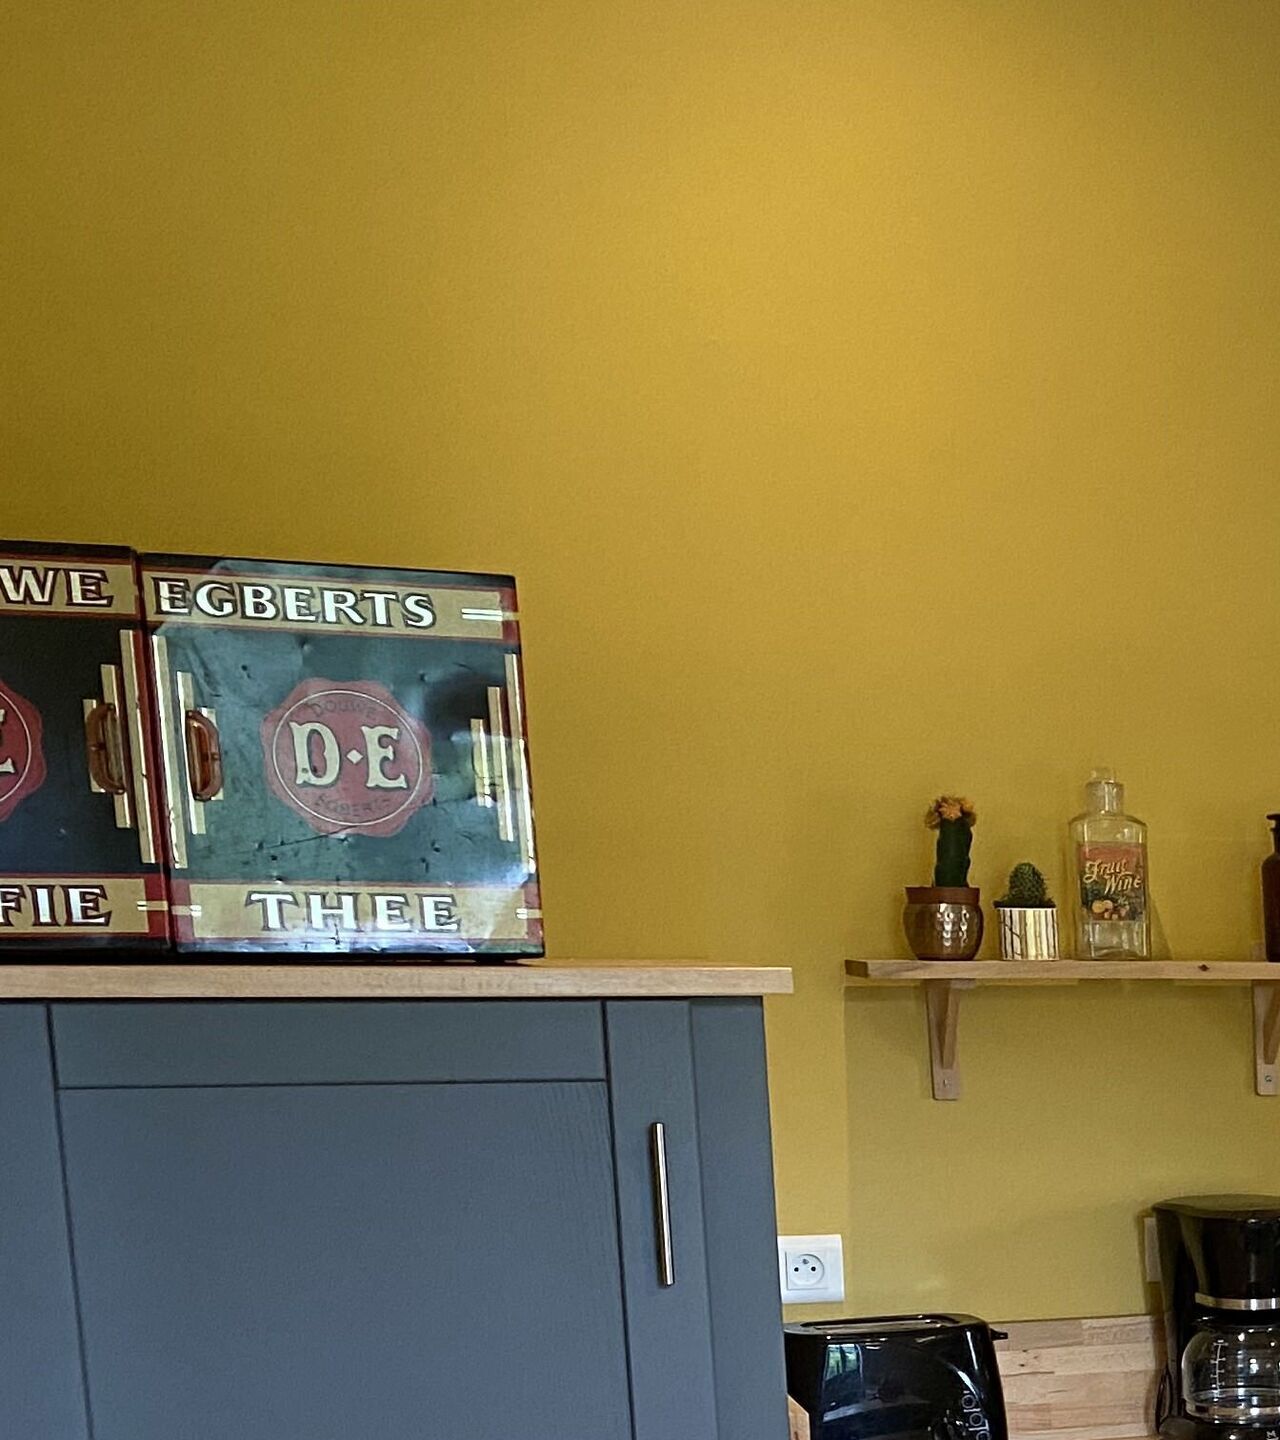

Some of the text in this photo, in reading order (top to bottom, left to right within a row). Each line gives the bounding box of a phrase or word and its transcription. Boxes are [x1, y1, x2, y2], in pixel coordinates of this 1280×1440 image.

[151, 577, 436, 628] EGBERTS
[1104, 873, 1142, 895] Wine
[245, 890, 461, 933] THEE
